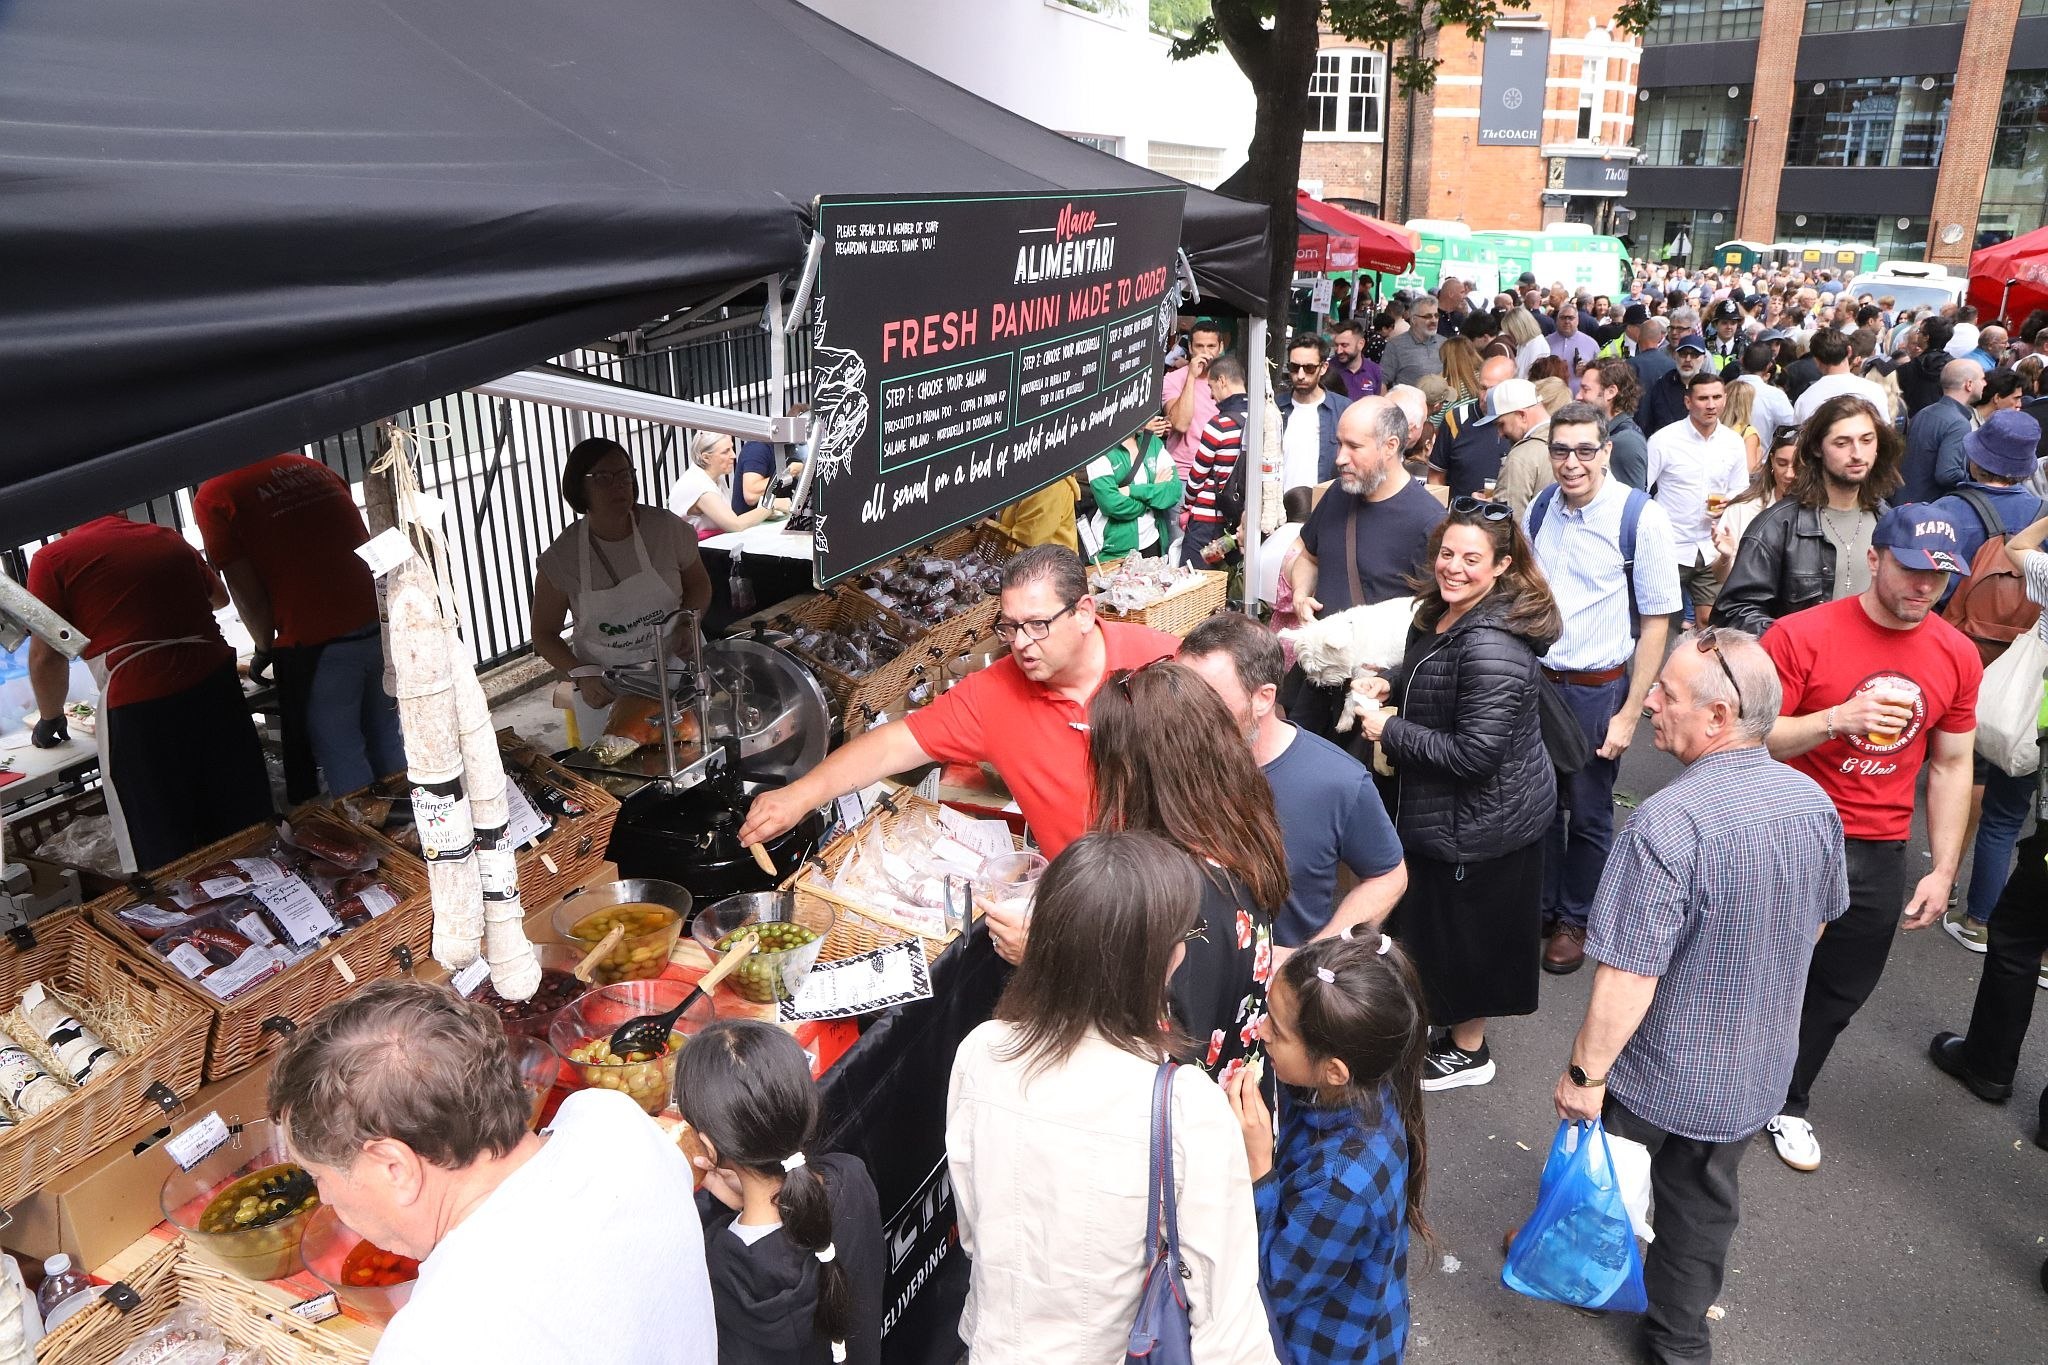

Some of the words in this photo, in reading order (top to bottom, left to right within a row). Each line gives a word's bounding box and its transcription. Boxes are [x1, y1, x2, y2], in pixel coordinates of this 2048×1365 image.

[836, 224, 857, 239] PLEASE
[859, 223, 877, 237] SPEAK
[878, 223, 885, 236] TO
[886, 222, 891, 236] A
[893, 222, 915, 236] MEMBER
[915, 221, 923, 234] OF
[924, 220, 939, 234] STAFF
[1056, 202, 1097, 243] Marco
[835, 241, 868, 256] REGARDING
[901, 238, 919, 252] THANK
[1013, 236, 1116, 285] ALIMENTARI
[882, 308, 977, 363] FRESH
[991, 294, 1061, 341] PANINI
[1067, 282, 1113, 323] MADE
[1117, 280, 1131, 309] TO
[1134, 266, 1167, 303] ORDER
[1022, 355, 1035, 372] STEP
[1043, 347, 1061, 366] CHOOSE
[885, 387, 906, 409] STEP
[917, 377, 943, 400] CHOOSE
[946, 373, 964, 393] YOUR
[965, 368, 987, 389] SALAMI
[884, 414, 915, 435] PROSCIUTTO
[916, 412, 922, 425] DI
[922, 408, 940, 424] PARMA
[960, 398, 976, 413] COPPA
[883, 439, 907, 458] SALAME
[909, 433, 930, 451] MILANO
[861, 482, 886, 523] all
[892, 464, 931, 513] served
[934, 472, 950, 493] on
[954, 465, 966, 485] a
[969, 442, 994, 483] bed
[996, 445, 1009, 478] of
[1013, 423, 1044, 464] rocket
[1044, 412, 1070, 451] salad
[1070, 416, 1078, 439] in
[1080, 417, 1088, 432] a
[1915, 520, 1956, 542] KAPPA
[1839, 756, 1859, 774] G
[1859, 759, 1897, 776] Unit
[411, 799, 454, 812] aFelinese
